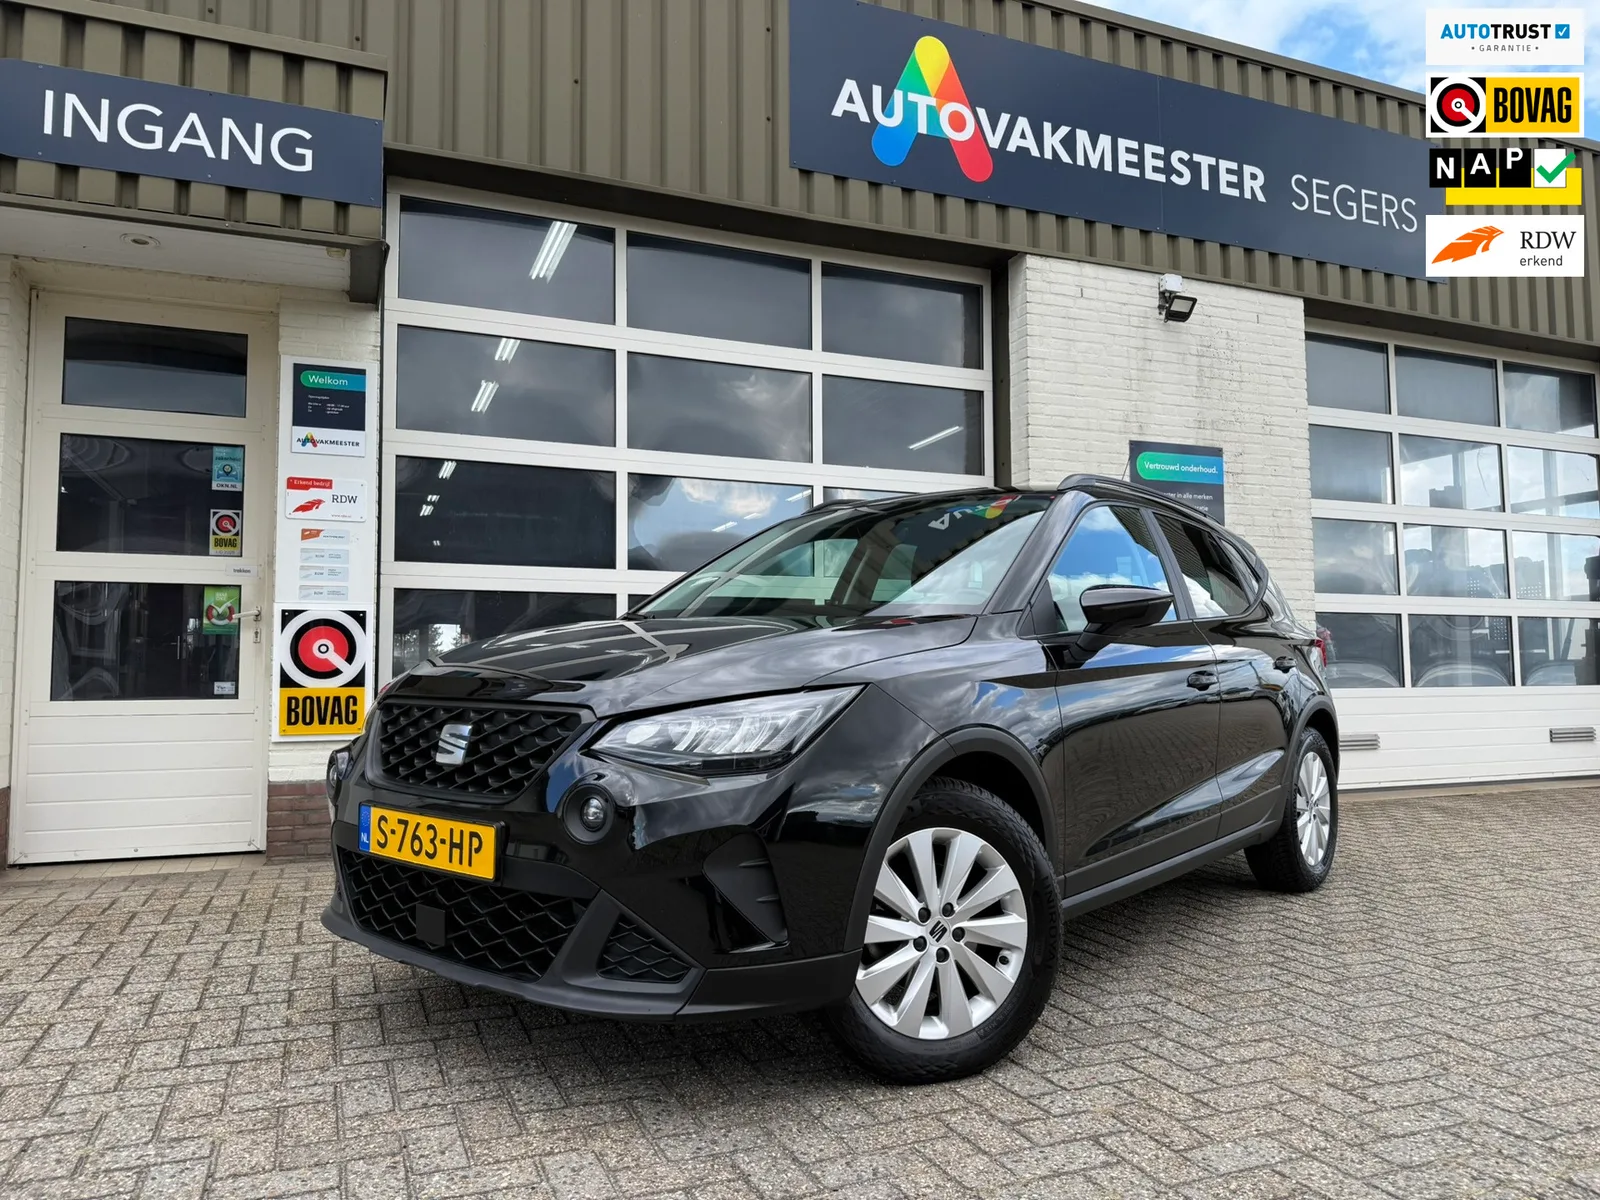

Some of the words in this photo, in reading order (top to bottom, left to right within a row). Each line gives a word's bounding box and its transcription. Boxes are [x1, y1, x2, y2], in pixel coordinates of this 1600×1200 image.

[43, 89, 313, 172] INGANG
[830, 78, 1267, 203] AUTOVAKMEESTER
[1290, 174, 1418, 234] SEGERS
[308, 374, 348, 386] Welkom
[1144, 461, 1180, 471] Vertrouwd
[1180, 464, 1219, 474] onderhoud.
[313, 480, 331, 488] bedrijf
[331, 494, 358, 504] RDW
[214, 537, 237, 548] BOVAG
[286, 695, 358, 726] BOVAG
[360, 832, 369, 844] NL
[376, 814, 483, 867] S-763-HP
